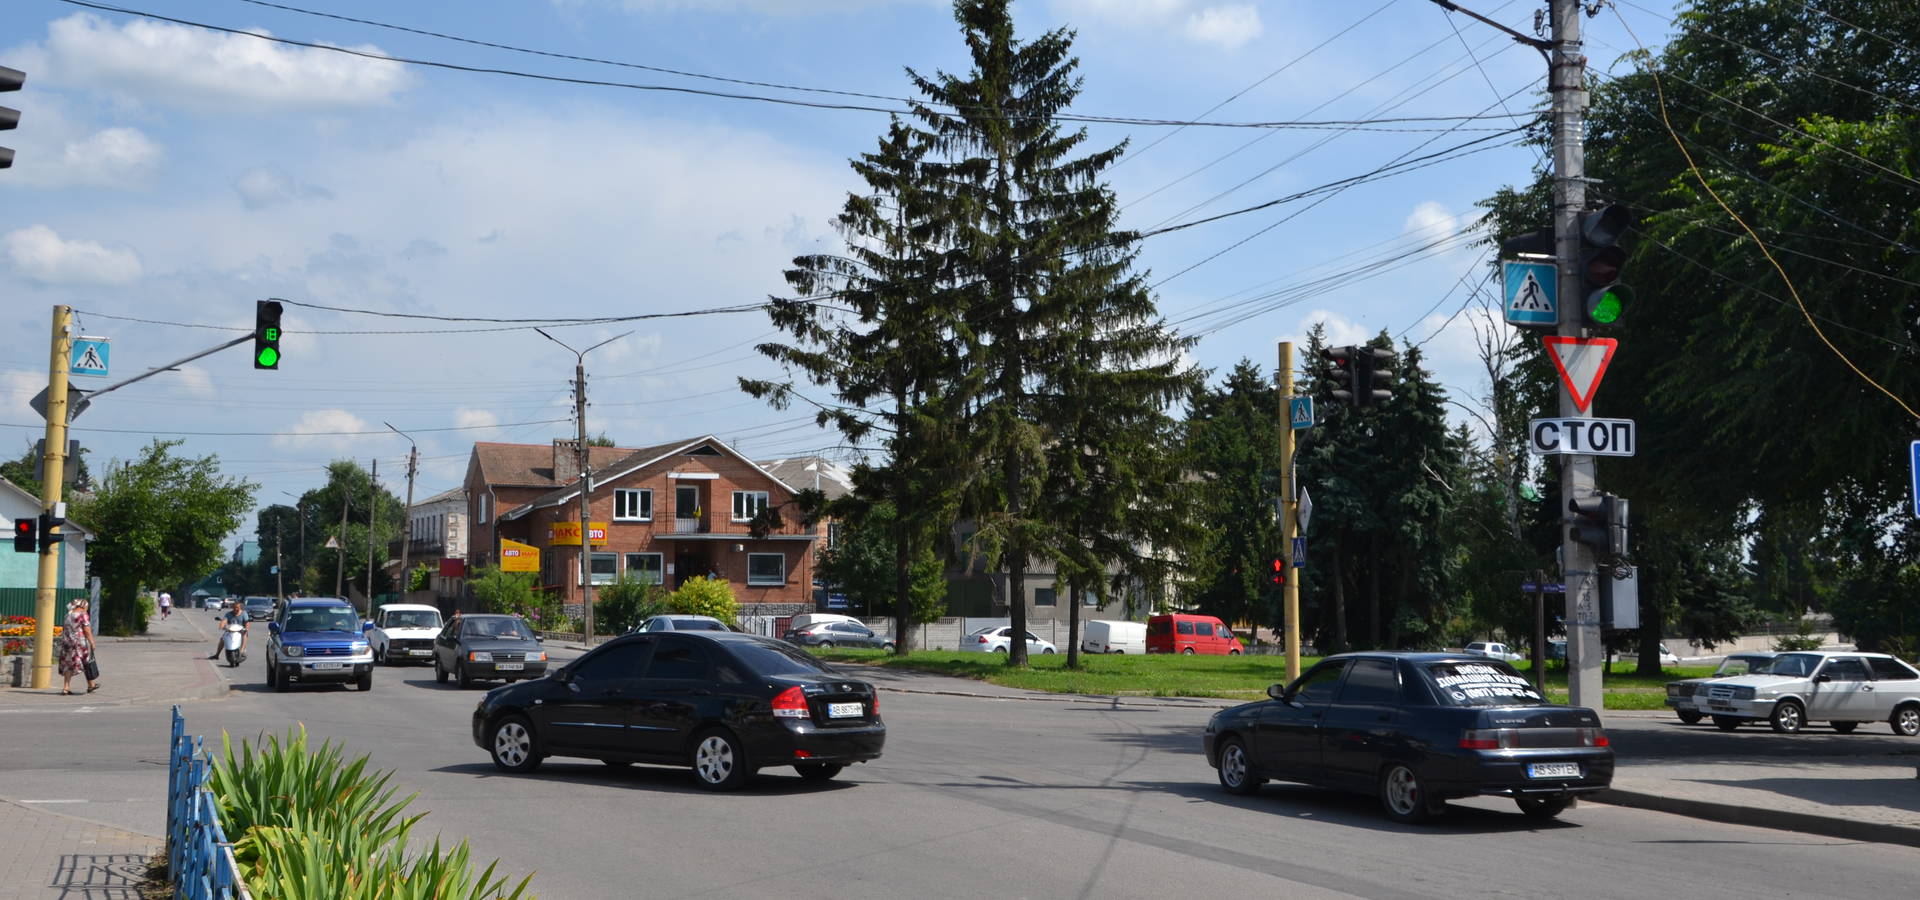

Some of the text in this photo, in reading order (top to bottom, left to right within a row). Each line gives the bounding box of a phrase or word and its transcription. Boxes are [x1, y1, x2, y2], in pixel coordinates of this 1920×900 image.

[266, 328, 277, 341] 18
[1534, 421, 1631, 452] СТОП
[589, 530, 603, 539] ВТО
[504, 549, 520, 557] АВТО
[1436, 674, 1494, 688] ДОМАШНЯ
